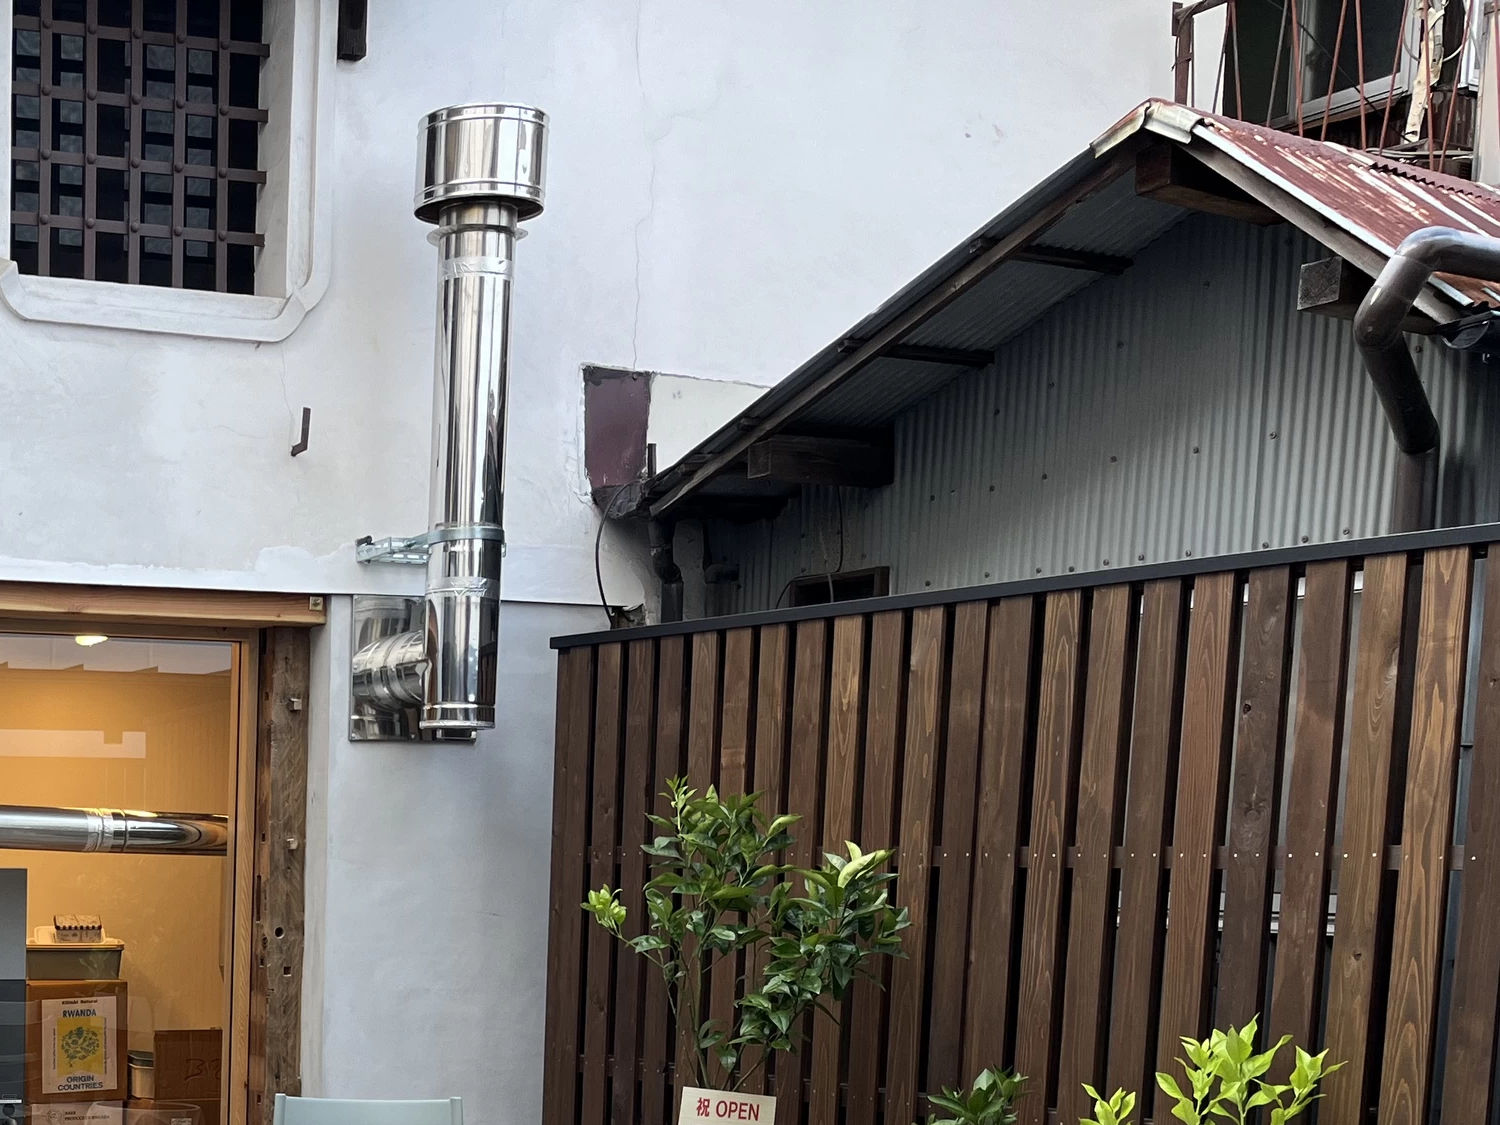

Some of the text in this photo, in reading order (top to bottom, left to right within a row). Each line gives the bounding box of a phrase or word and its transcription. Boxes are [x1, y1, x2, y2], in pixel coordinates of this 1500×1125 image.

[62, 1008, 97, 1018] RWANDA
[66, 1075, 95, 1084] ORIGIN
[57, 1081, 104, 1091] COUNTRIES
[696, 1097, 760, 1121] 祝 OPEN
